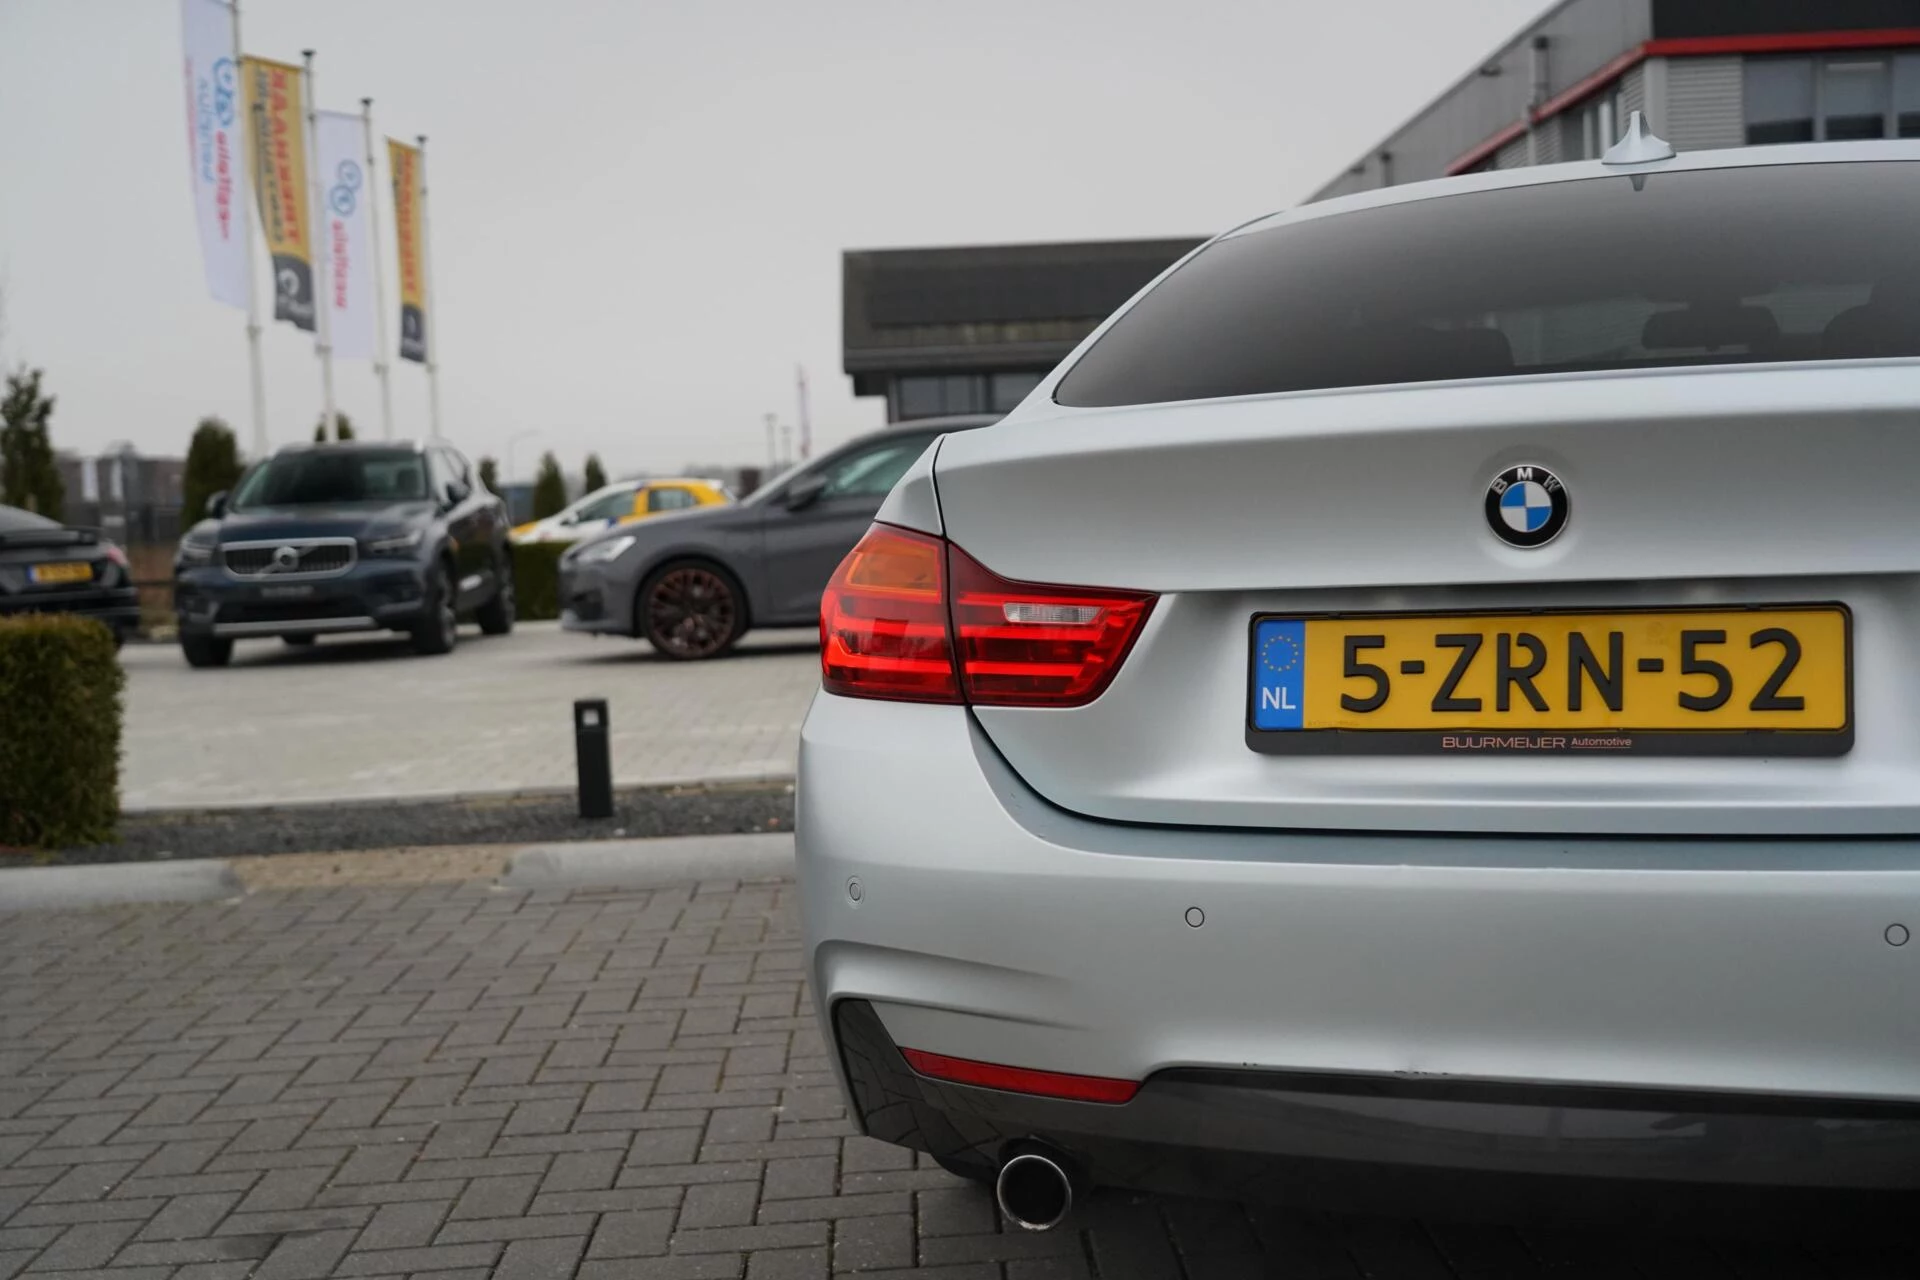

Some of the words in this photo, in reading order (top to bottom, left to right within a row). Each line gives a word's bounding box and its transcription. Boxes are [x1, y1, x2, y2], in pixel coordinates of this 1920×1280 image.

[1491, 467, 1561, 495] BMW
[1340, 628, 1806, 714] 5-ZRN-52
[1261, 686, 1296, 710] NL
[1442, 736, 1566, 748] BUURMEIJER
[1571, 738, 1632, 746] Automotive
